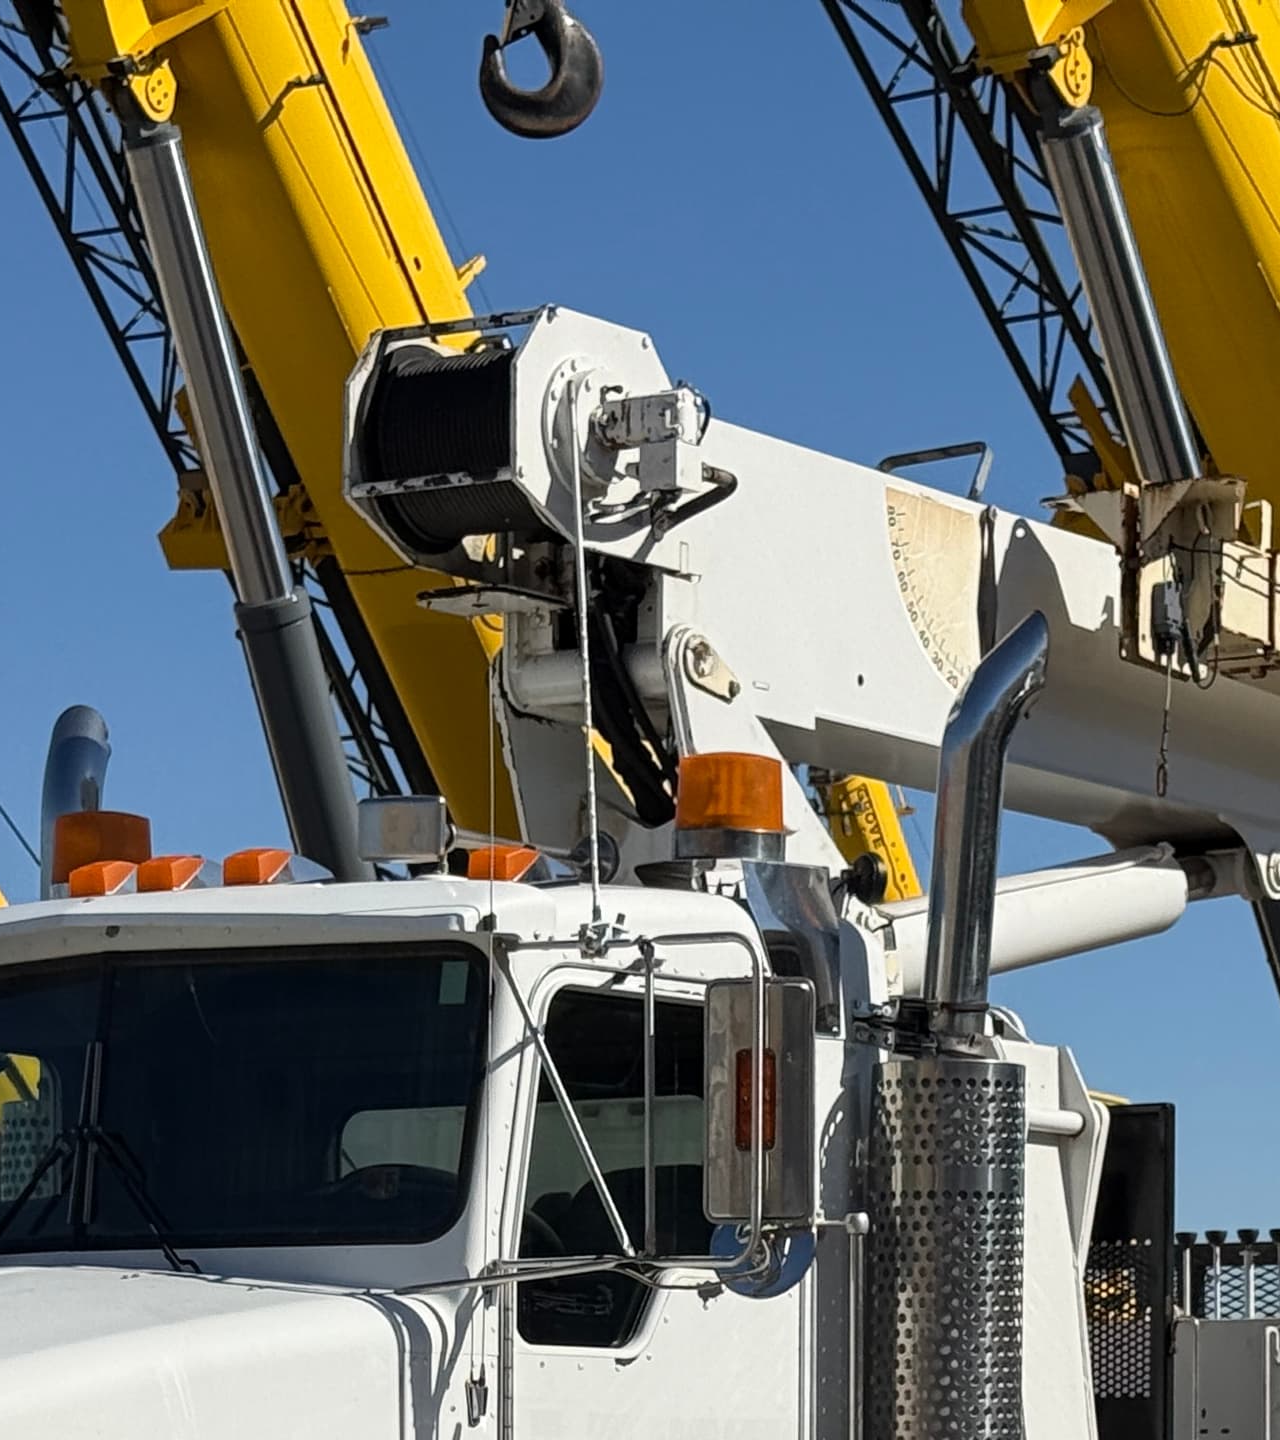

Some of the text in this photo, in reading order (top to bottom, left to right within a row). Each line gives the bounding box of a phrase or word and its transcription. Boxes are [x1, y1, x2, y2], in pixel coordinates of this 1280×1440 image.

[891, 538, 902, 560] 70
[897, 571, 909, 593] 60
[906, 601, 918, 623] 50
[919, 630, 931, 649] 40
[931, 651, 944, 672] 30
[946, 670, 960, 689] 20
